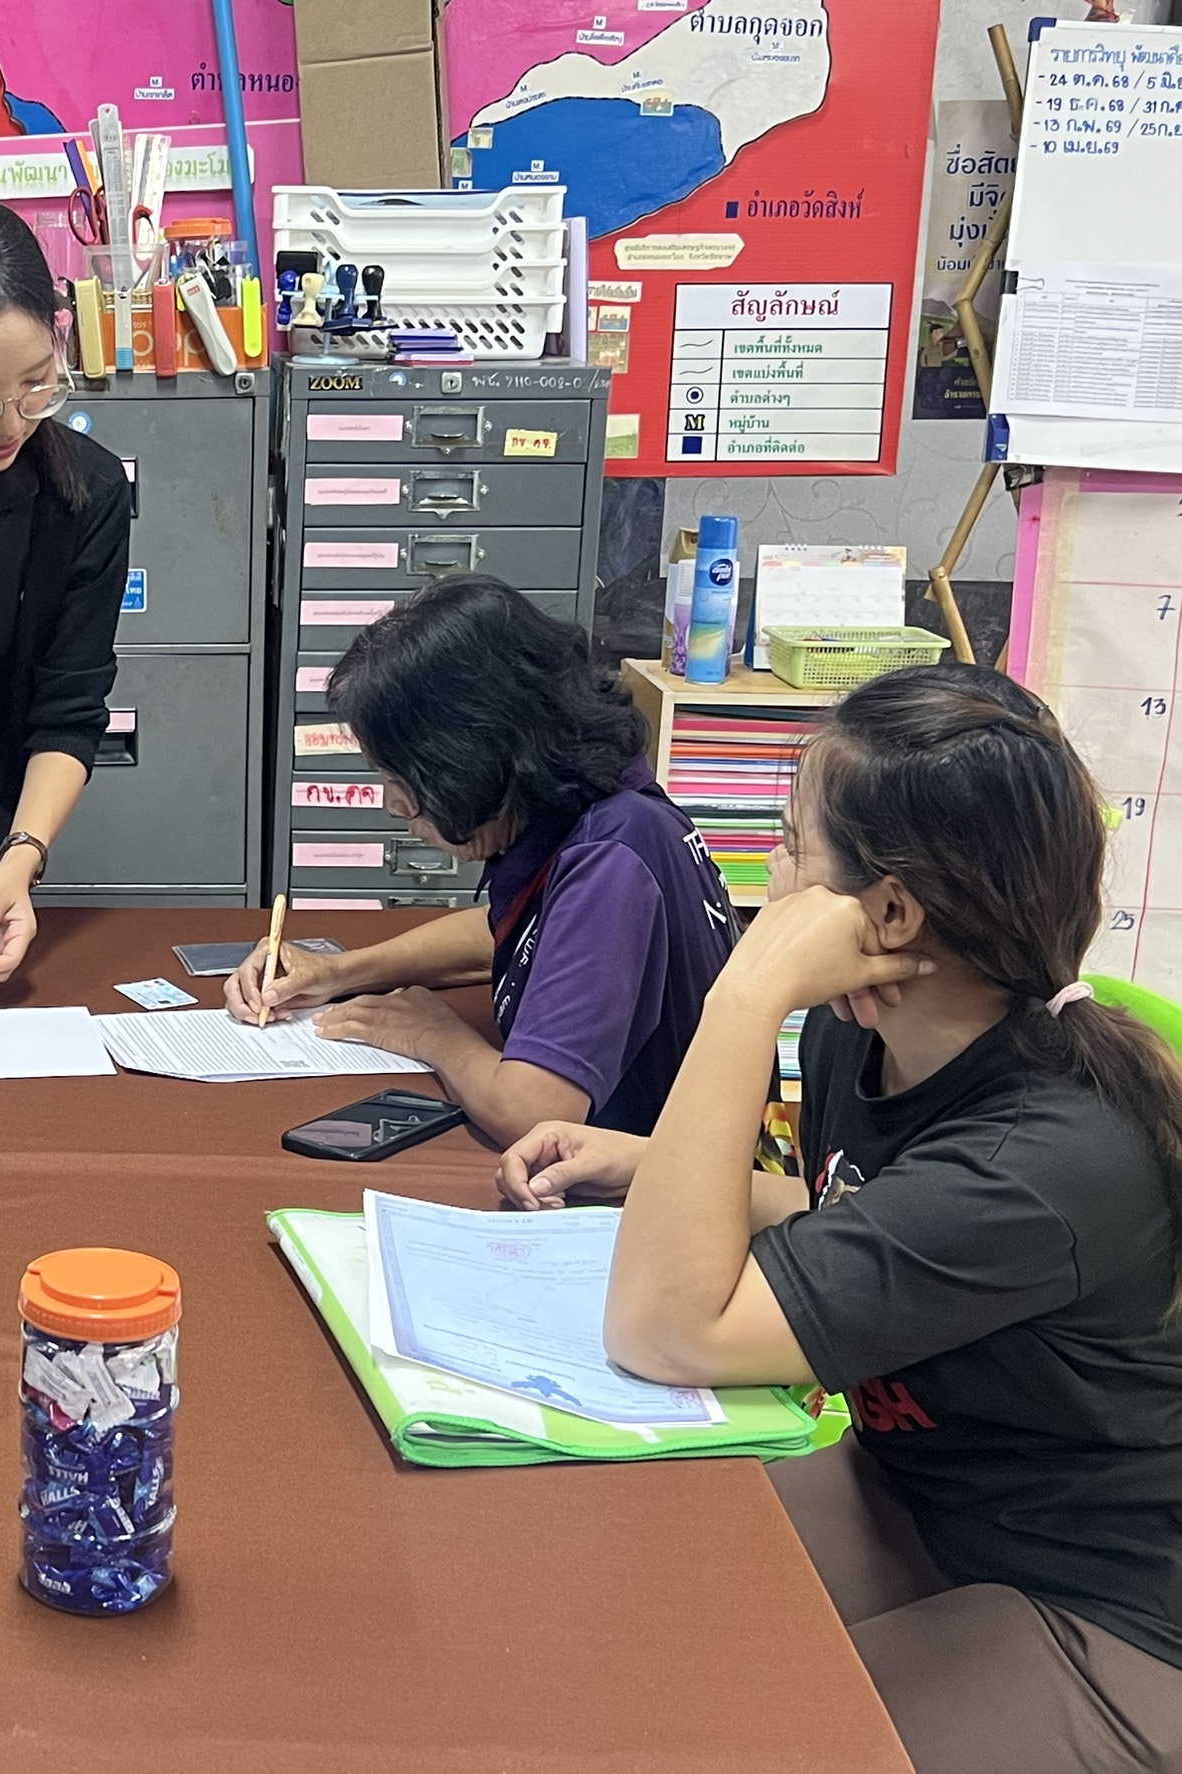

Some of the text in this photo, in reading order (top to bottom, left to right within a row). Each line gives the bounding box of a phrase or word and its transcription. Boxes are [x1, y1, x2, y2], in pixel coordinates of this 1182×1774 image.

[1050, 43, 1126, 72] รายการวิทยุ
[1049, 73, 1067, 86] 24
[1112, 75, 1129, 88] 68
[1046, 98, 1062, 111] 19
[1108, 99, 1124, 112] 68
[1044, 119, 1060, 131] 13
[1106, 120, 1122, 133] 69
[1043, 141, 1057, 153] 10
[747, 188, 866, 221] อำเภอวัดสิงห์
[730, 289, 840, 322] สัญลักษณ์
[733, 335, 823, 355] เขตพื้นที่ทั้งหมด
[732, 361, 804, 380] เขตแบ่งพื้นที่
[309, 375, 362, 390] ZOOM
[730, 389, 791, 406] ตำบลต่างๆ
[684, 414, 705, 431] M
[729, 413, 770, 434] หมู่บ้าน
[727, 440, 806, 455] อำเภอที่ติดต่อ
[1156, 594, 1176, 620] 7
[1139, 697, 1167, 716] 13
[1121, 797, 1146, 820] 19
[1109, 910, 1135, 931] 25
